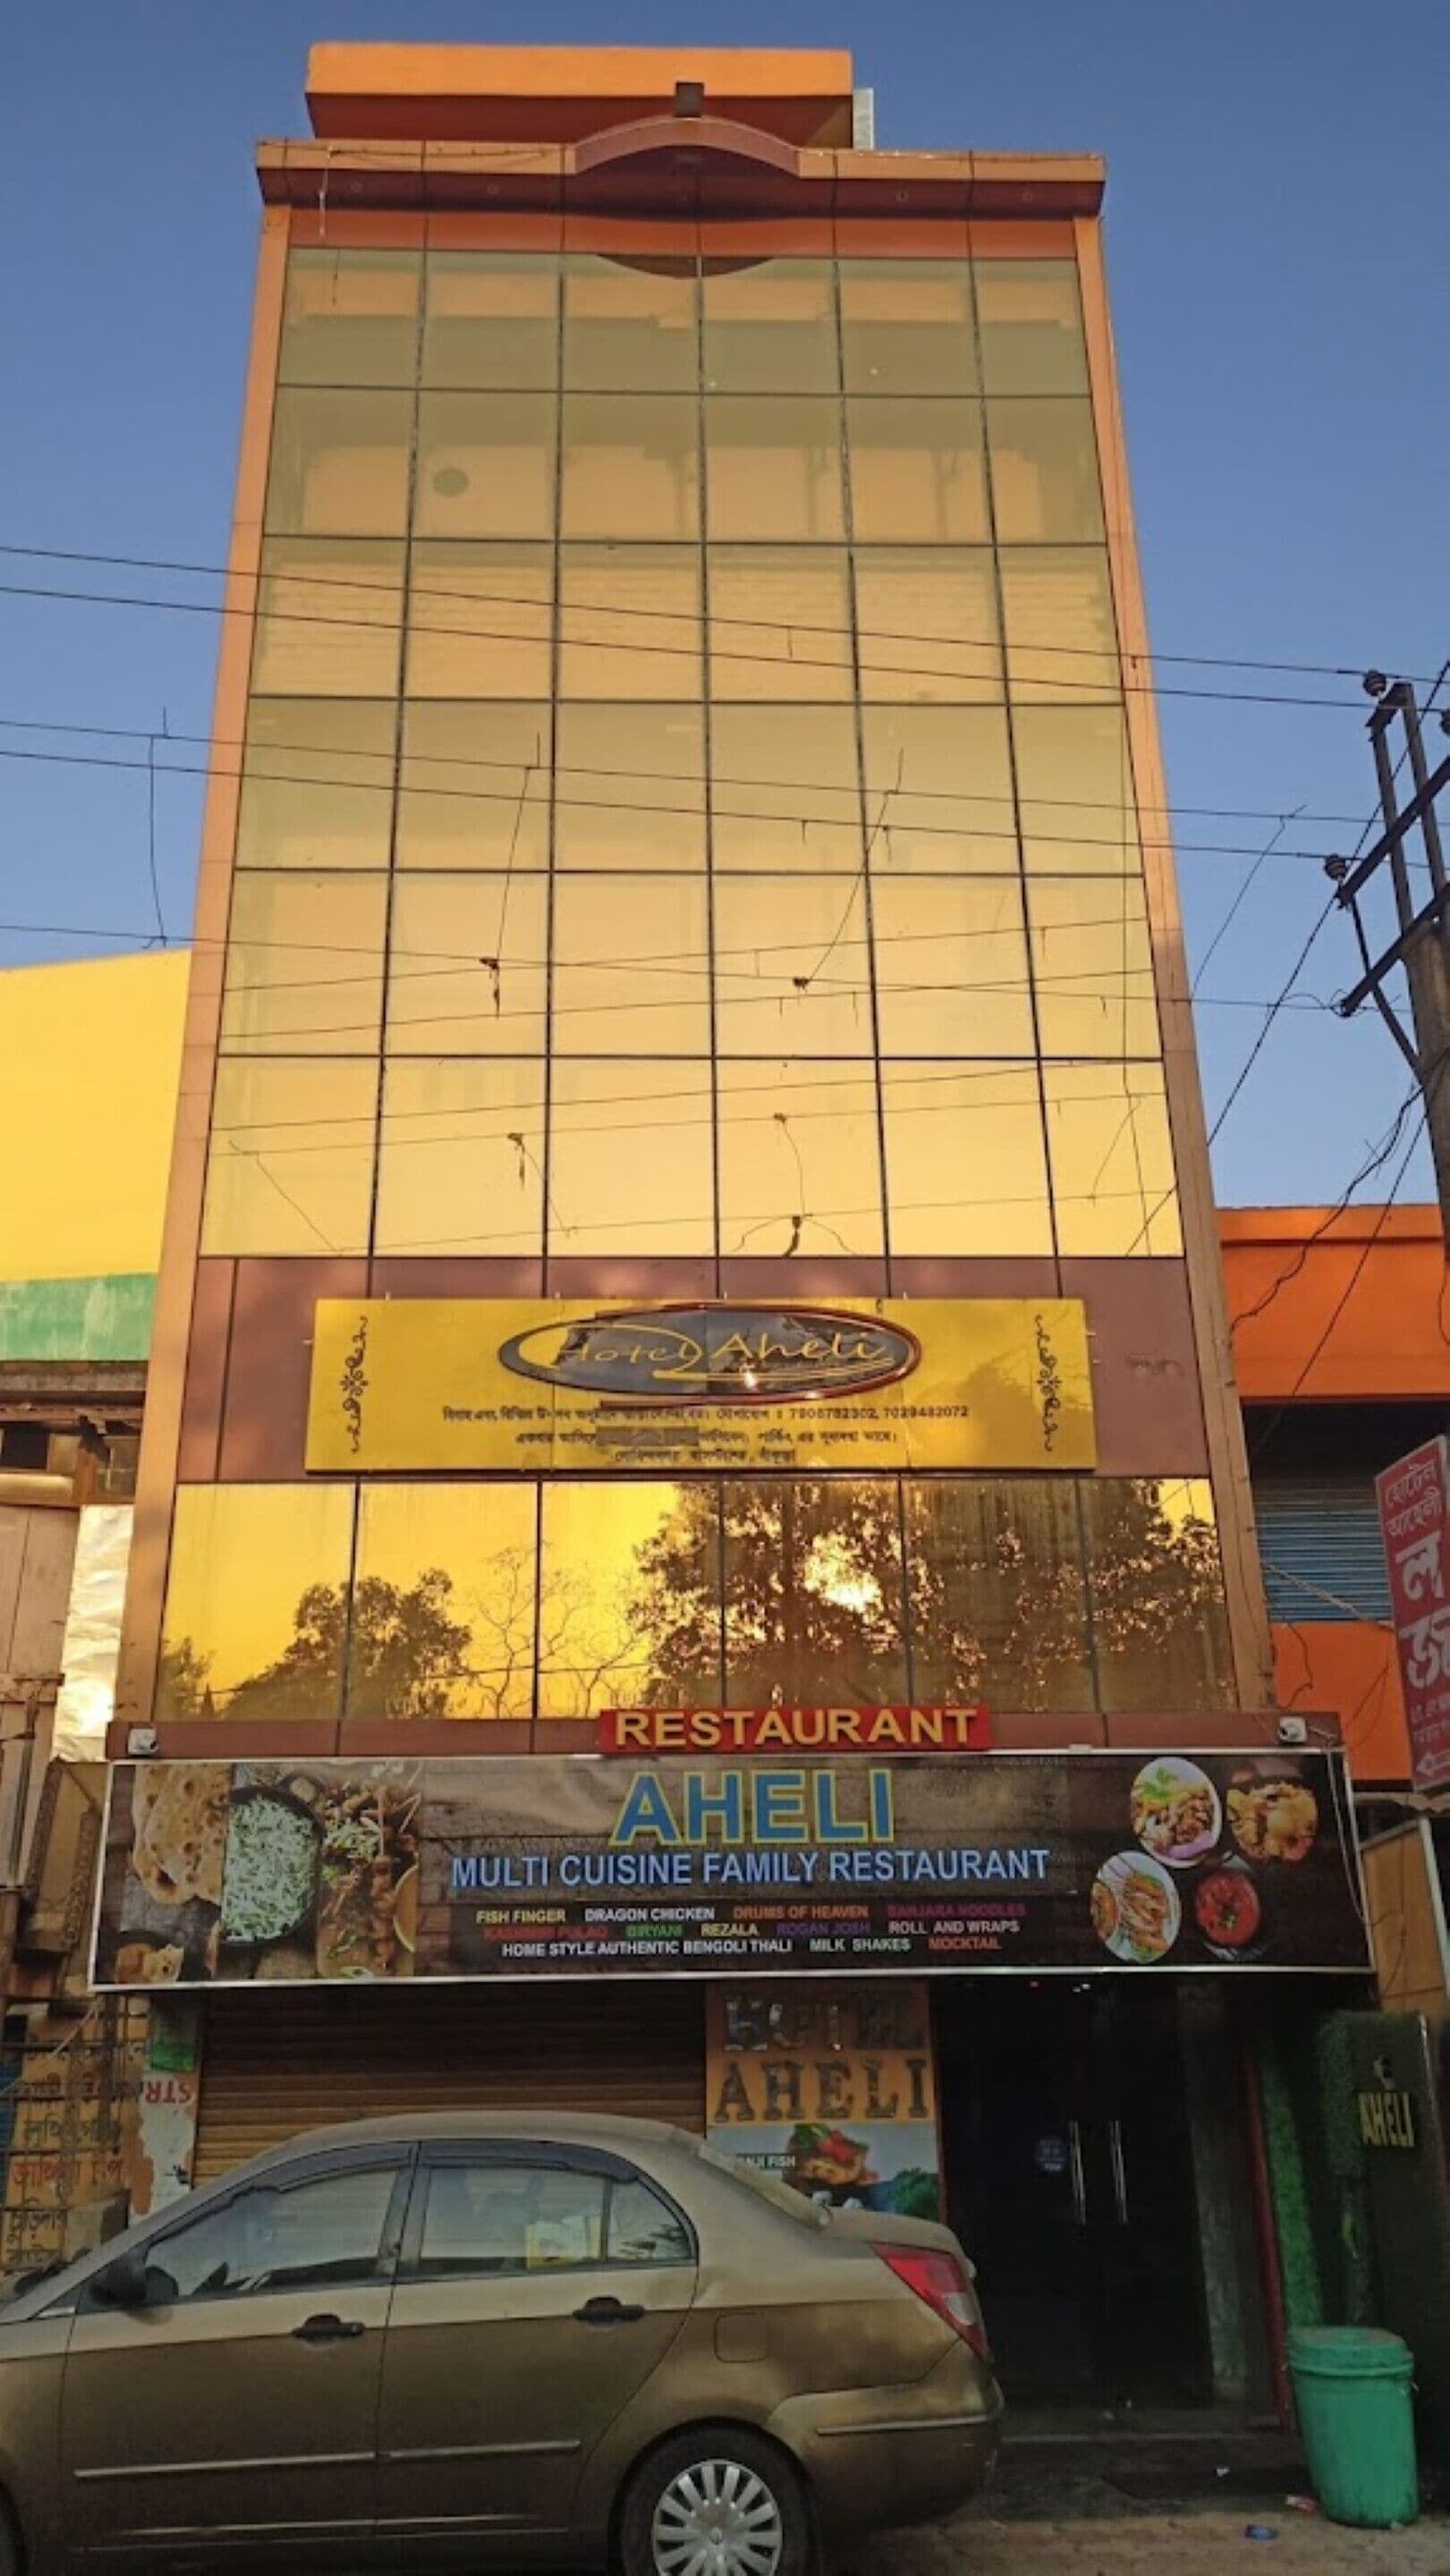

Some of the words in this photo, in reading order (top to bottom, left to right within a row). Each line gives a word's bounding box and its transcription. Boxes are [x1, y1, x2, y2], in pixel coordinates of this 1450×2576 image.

[713, 1331, 887, 1361] Aheli
[615, 1708, 977, 1747] RESTAURANT
[609, 1769, 895, 1846] AHELI
[451, 1855, 549, 1889] MULTI
[560, 1852, 691, 1887] CUISINE
[703, 1852, 819, 1884] FAMILY
[830, 1848, 1050, 1882] RESTAURANT
[476, 1910, 510, 1924] FISH
[513, 1909, 566, 1923] FINGER
[585, 1907, 647, 1922] DRAGON
[650, 1907, 715, 1920] CHICKEN
[733, 1906, 785, 1919] DRUMS
[789, 1906, 808, 1919] OF
[811, 1905, 869, 1919] HEAVEN
[958, 1902, 1026, 1917] NOODLES
[625, 1924, 683, 1938] BIRYANI
[700, 1922, 759, 1937] REZALA
[776, 1922, 828, 1936] ROGAN
[832, 1922, 871, 1936] JOSH
[888, 1920, 927, 1935] ROLL
[933, 1920, 964, 1934] AND
[966, 1919, 1020, 1934] WRAPS
[502, 1943, 546, 1957] HOME
[549, 1942, 595, 1956] STYLE
[597, 1940, 680, 1955] AUTHENTIC
[683, 1939, 747, 1954] BENGOLI
[750, 1938, 793, 1953] THALI
[810, 1937, 844, 1952] MILK
[852, 1937, 912, 1951] SHAKES
[928, 1936, 1002, 1950] MOCKTAIL
[715, 2059, 929, 2123] AHELI
[1358, 2092, 1414, 2148] AHELI
